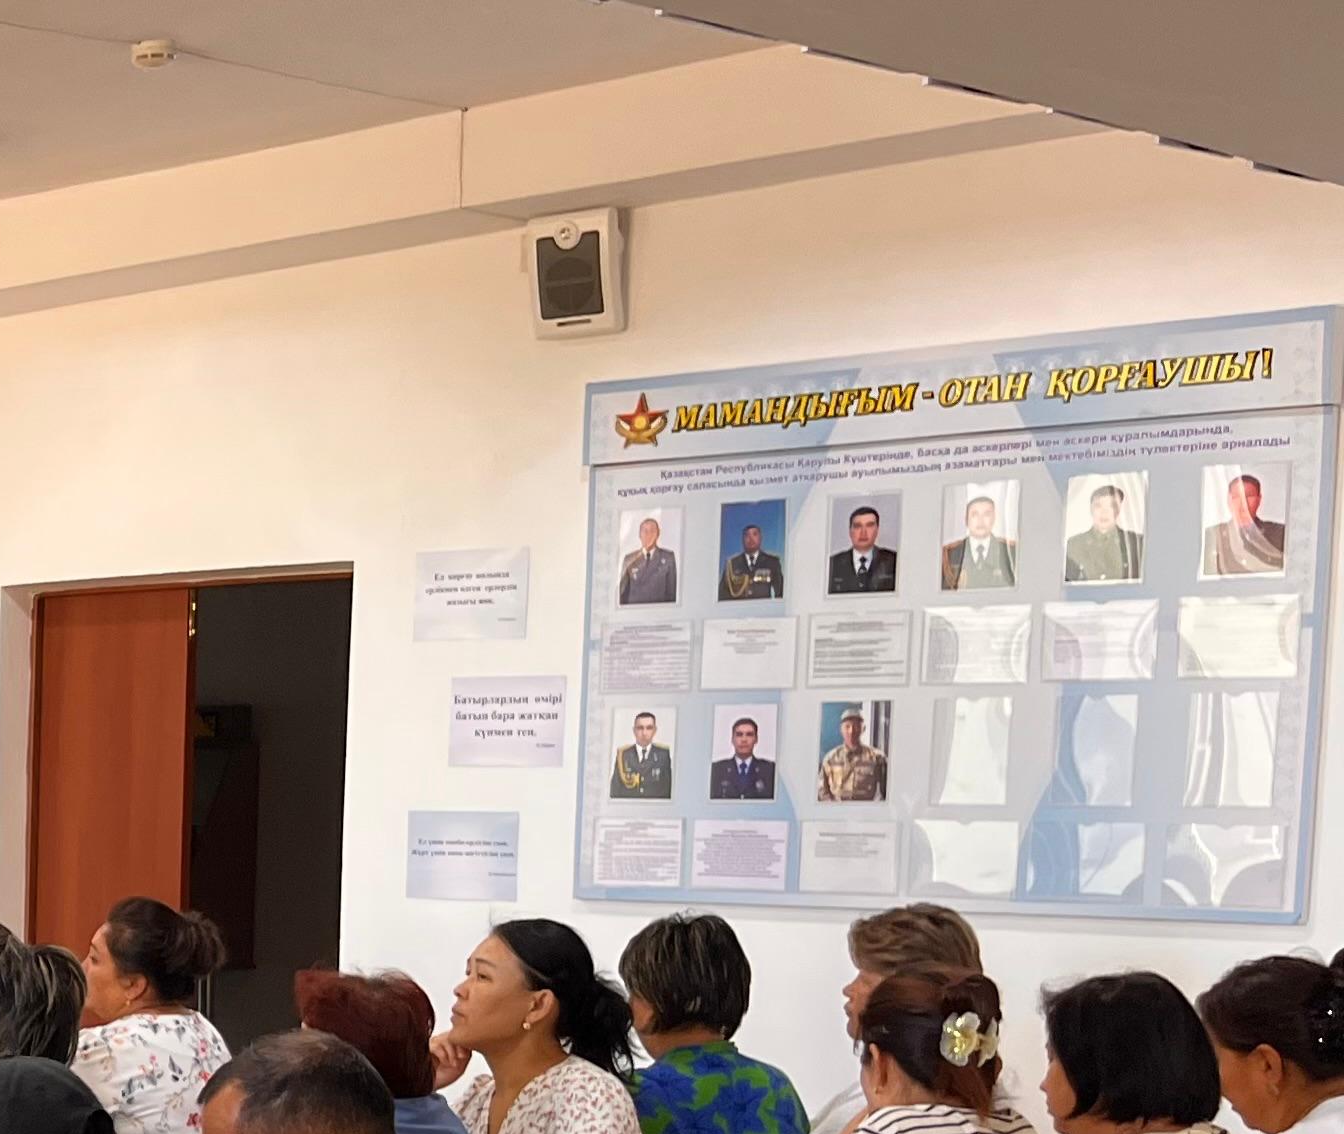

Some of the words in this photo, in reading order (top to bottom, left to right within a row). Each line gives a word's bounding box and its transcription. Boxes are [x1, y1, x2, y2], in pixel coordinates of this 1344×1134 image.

[672, 382, 919, 433] МАМАНДЫҒЫМ
[938, 371, 1032, 408] ОТАН
[1044, 347, 1274, 403] ҚОРҒАУШЫ!
